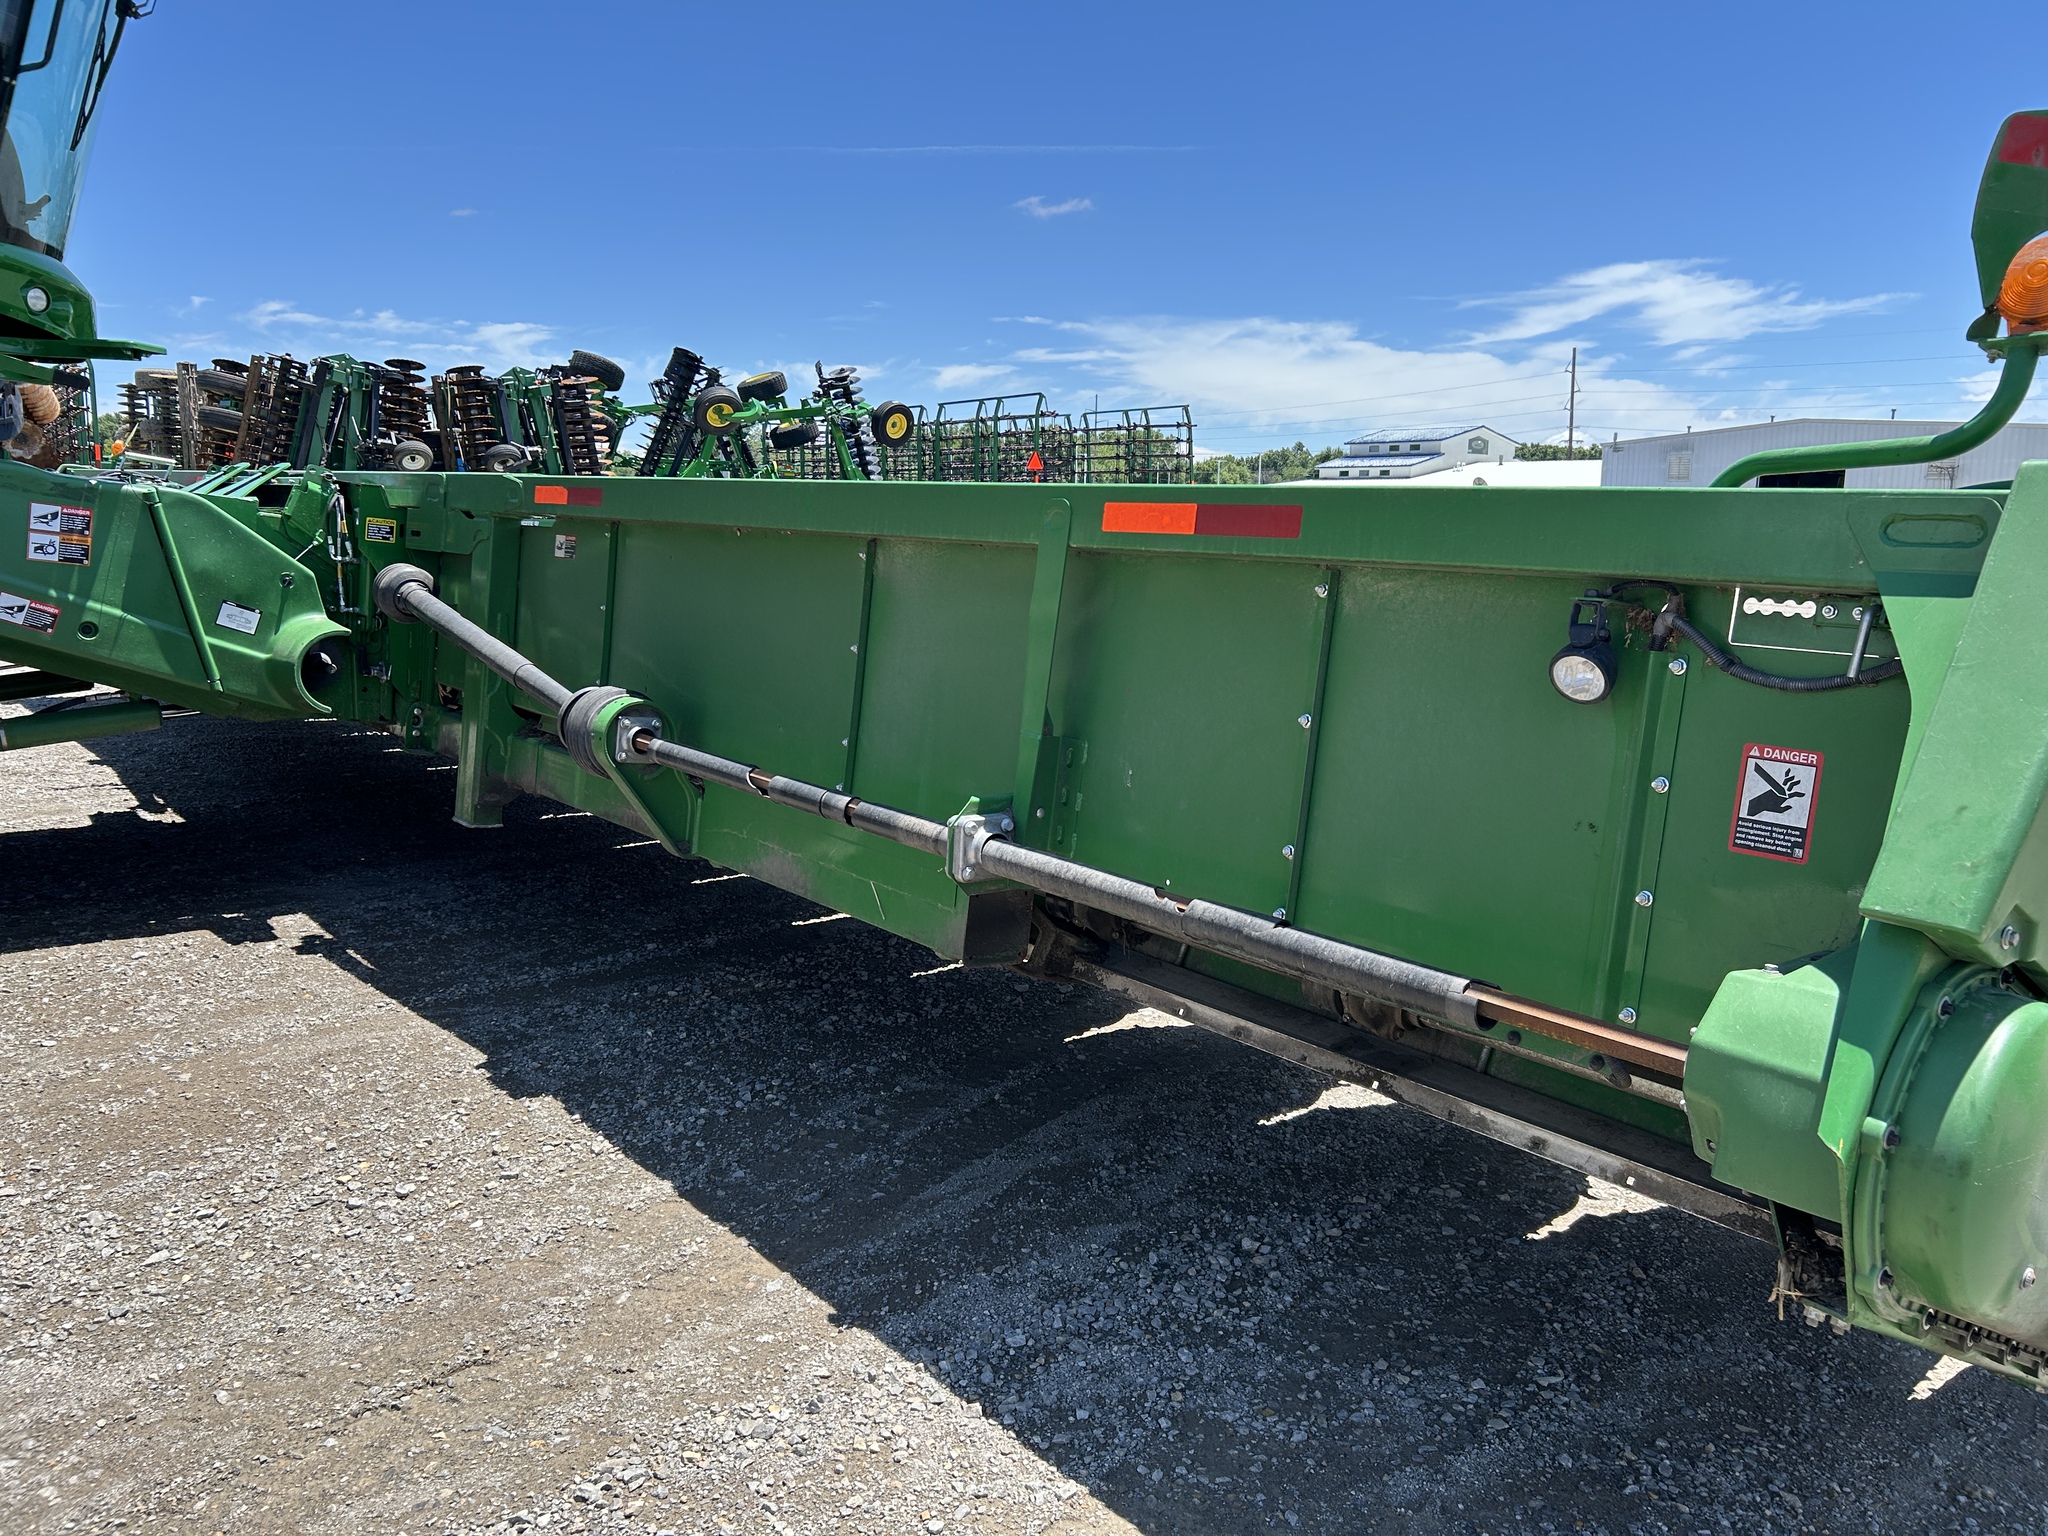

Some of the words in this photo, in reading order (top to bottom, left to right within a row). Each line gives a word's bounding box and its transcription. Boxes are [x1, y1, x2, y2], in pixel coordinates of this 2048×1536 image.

[35, 603, 59, 613] DANGER
[1763, 747, 1818, 765] DANGER
[1736, 827, 1771, 836] entanglement.
[1772, 826, 1787, 834] injury
[1734, 839, 1754, 847] opening
[1765, 836, 1774, 844] key
